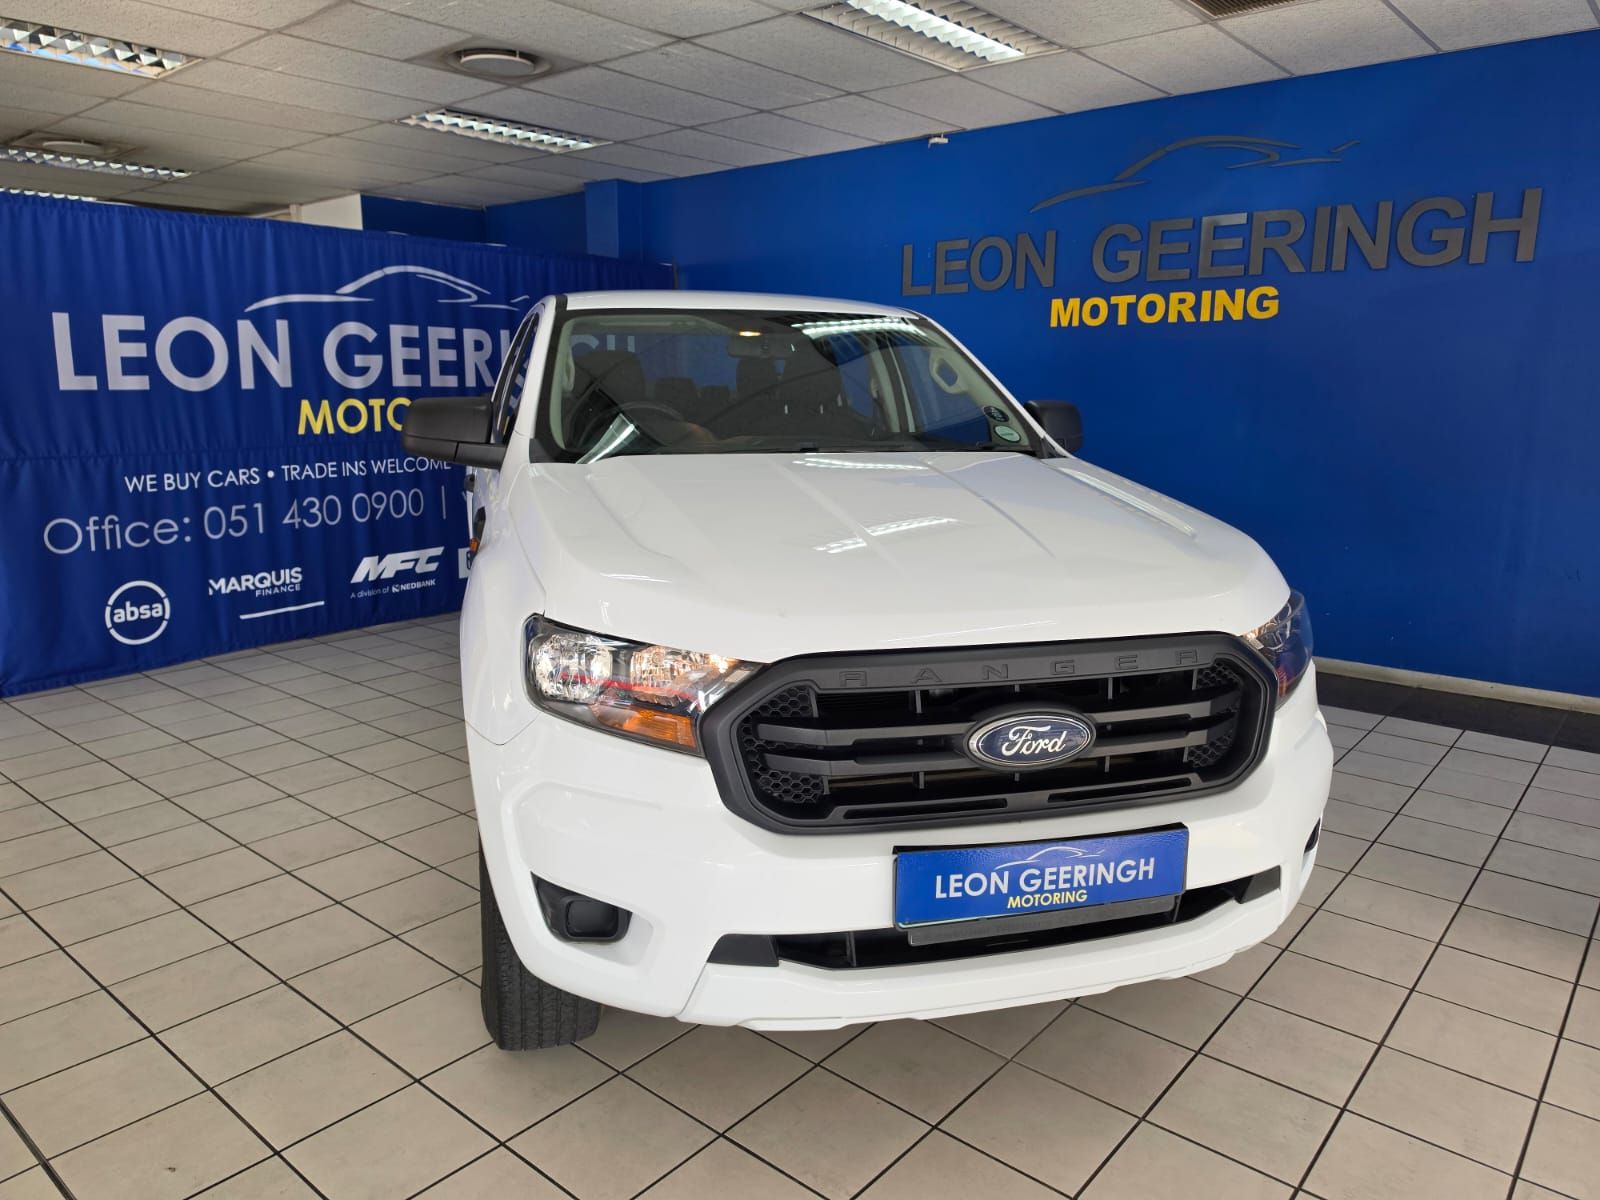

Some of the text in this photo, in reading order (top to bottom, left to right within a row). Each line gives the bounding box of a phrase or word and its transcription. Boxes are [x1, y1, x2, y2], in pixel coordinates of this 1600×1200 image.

[903, 188, 1542, 296] LEON GEERINGH
[1050, 286, 1280, 328] MOTORING
[52, 312, 293, 392] LEON
[298, 397, 412, 435] MOTO
[124, 467, 260, 494] WE BUY CARS
[281, 461, 338, 481] TRADE
[342, 460, 367, 477] INS
[43, 488, 424, 554] Office: 051 430 0900
[208, 567, 303, 596] MARQUIS
[350, 546, 445, 584] MFC
[255, 583, 301, 597] FINANCE
[357, 588, 381, 598] division
[382, 587, 390, 595] of
[113, 601, 164, 623] absa
[838, 649, 1198, 688] RANGER
[1001, 725, 1066, 757] Ford
[935, 857, 1155, 899] LEON GEERINGH
[1007, 889, 1088, 909] MOTORING
